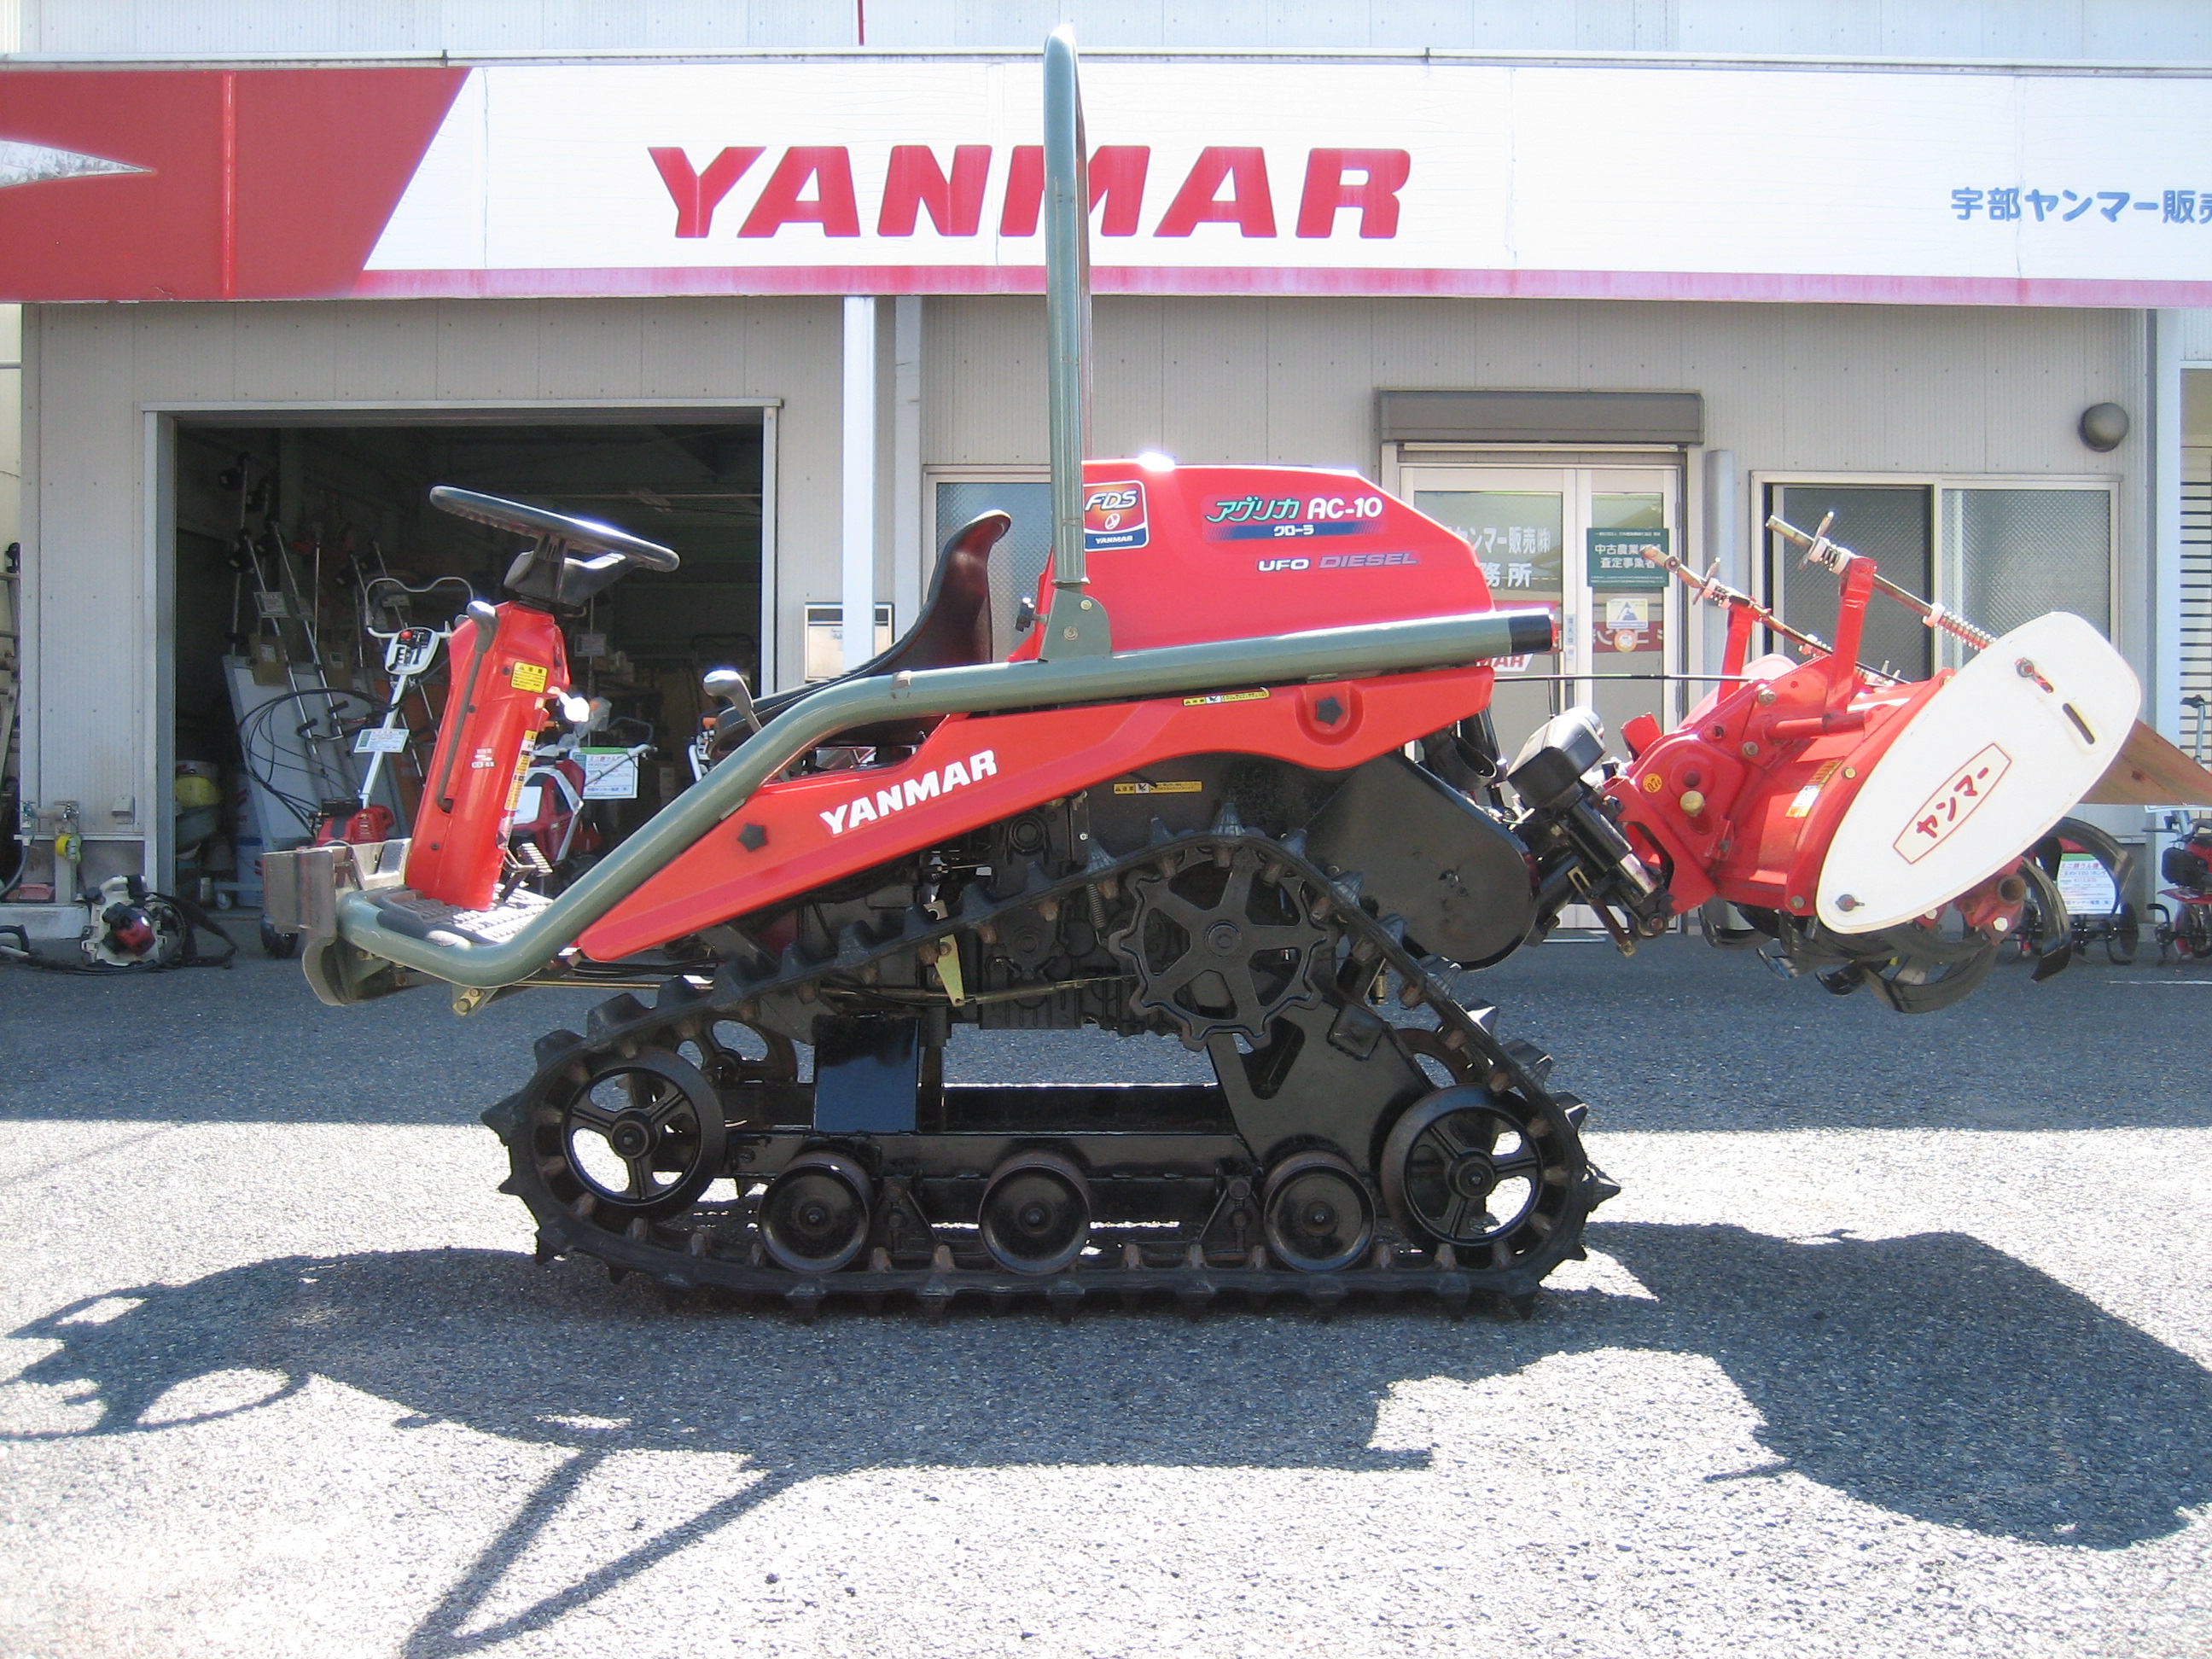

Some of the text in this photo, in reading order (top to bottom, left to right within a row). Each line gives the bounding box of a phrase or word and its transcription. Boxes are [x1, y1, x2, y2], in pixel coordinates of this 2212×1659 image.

[647, 144, 1411, 238] YANMAR
[1085, 490, 1138, 511] FDS
[1206, 496, 1382, 522] アグリカ AC-10
[1095, 535, 1133, 544] YANMAR
[1273, 524, 1314, 536] クローラ
[1595, 544, 1662, 555] 中古農業
[1257, 552, 1417, 571] UFO DIESEL
[819, 749, 998, 835] YANMAR
[1916, 767, 1989, 838] ヤンマー
